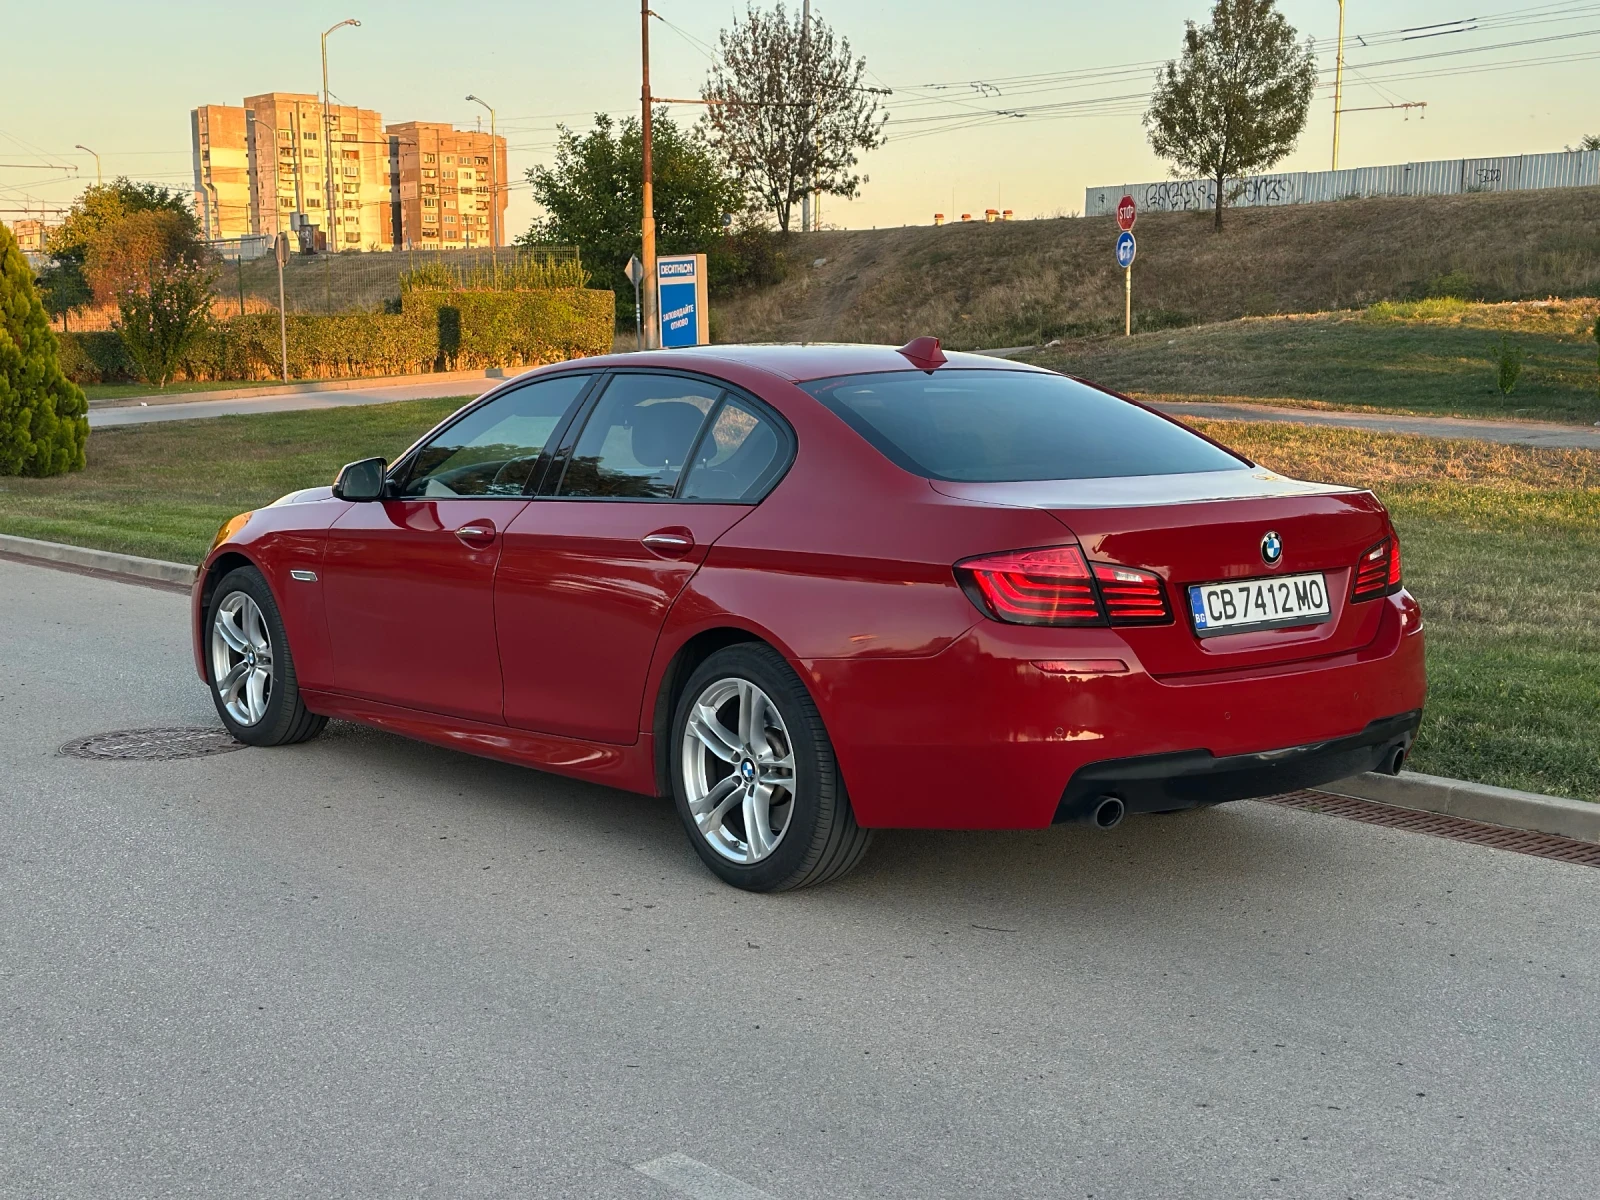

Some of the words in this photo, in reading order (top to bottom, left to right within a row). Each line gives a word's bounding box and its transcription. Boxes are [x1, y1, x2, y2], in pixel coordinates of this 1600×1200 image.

[1119, 205, 1134, 220] STOP
[660, 263, 693, 275] DECATHLON
[1195, 612, 1206, 624] BG
